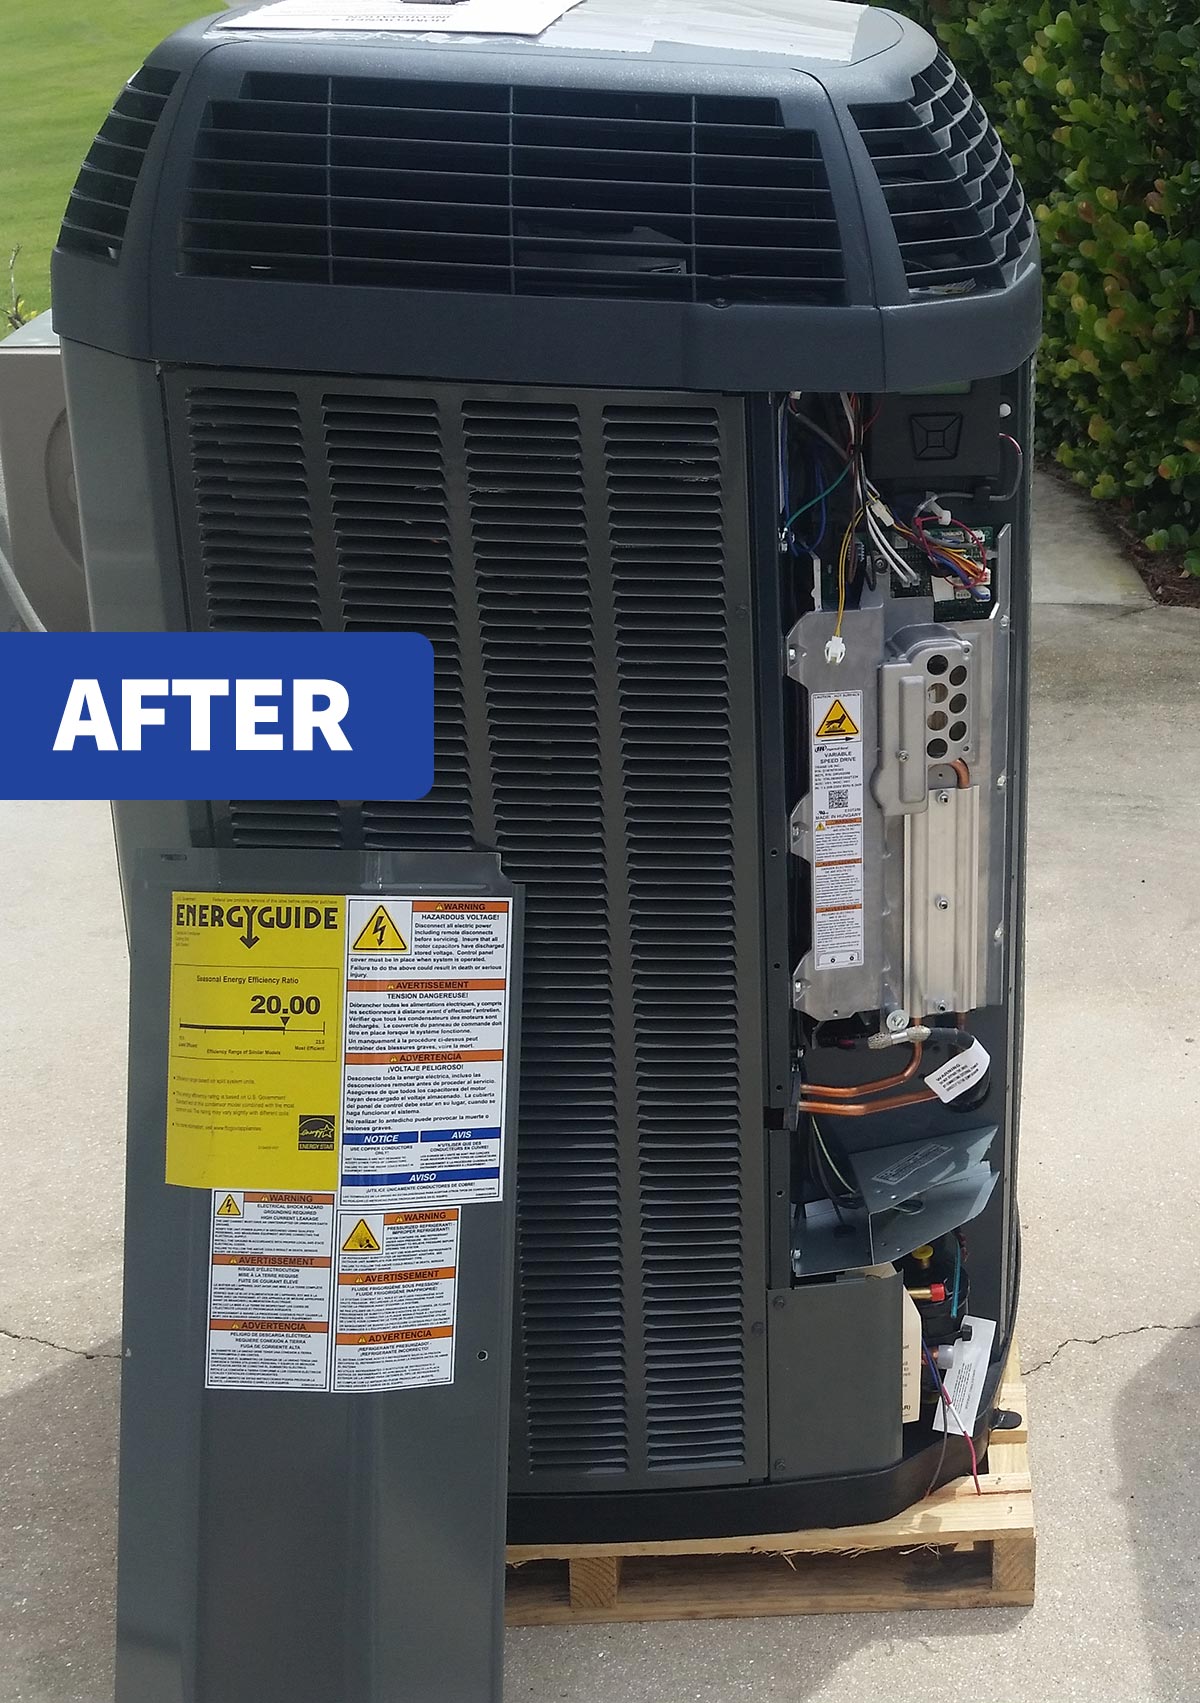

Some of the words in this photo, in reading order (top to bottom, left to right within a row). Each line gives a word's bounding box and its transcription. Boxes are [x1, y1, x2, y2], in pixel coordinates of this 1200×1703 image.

[176, 904, 338, 931] ENERGYGUIDE
[223, 976, 246, 984] Energy
[248, 977, 280, 985] Efficiency
[250, 995, 320, 1014] 20.00
[936, 1064, 960, 1081] WARNING
[364, 1135, 399, 1143] NOTICE
[452, 1131, 471, 1139] AVIS
[409, 1173, 436, 1182] AVISO
[404, 1212, 446, 1220] WARNING
[239, 1257, 314, 1265] AVERTISSEMENT
[365, 1271, 439, 1282] AVERTISSEMENT
[242, 1322, 306, 1330] ADVERTENCIA
[369, 1330, 432, 1342] ADVERTENCIA
